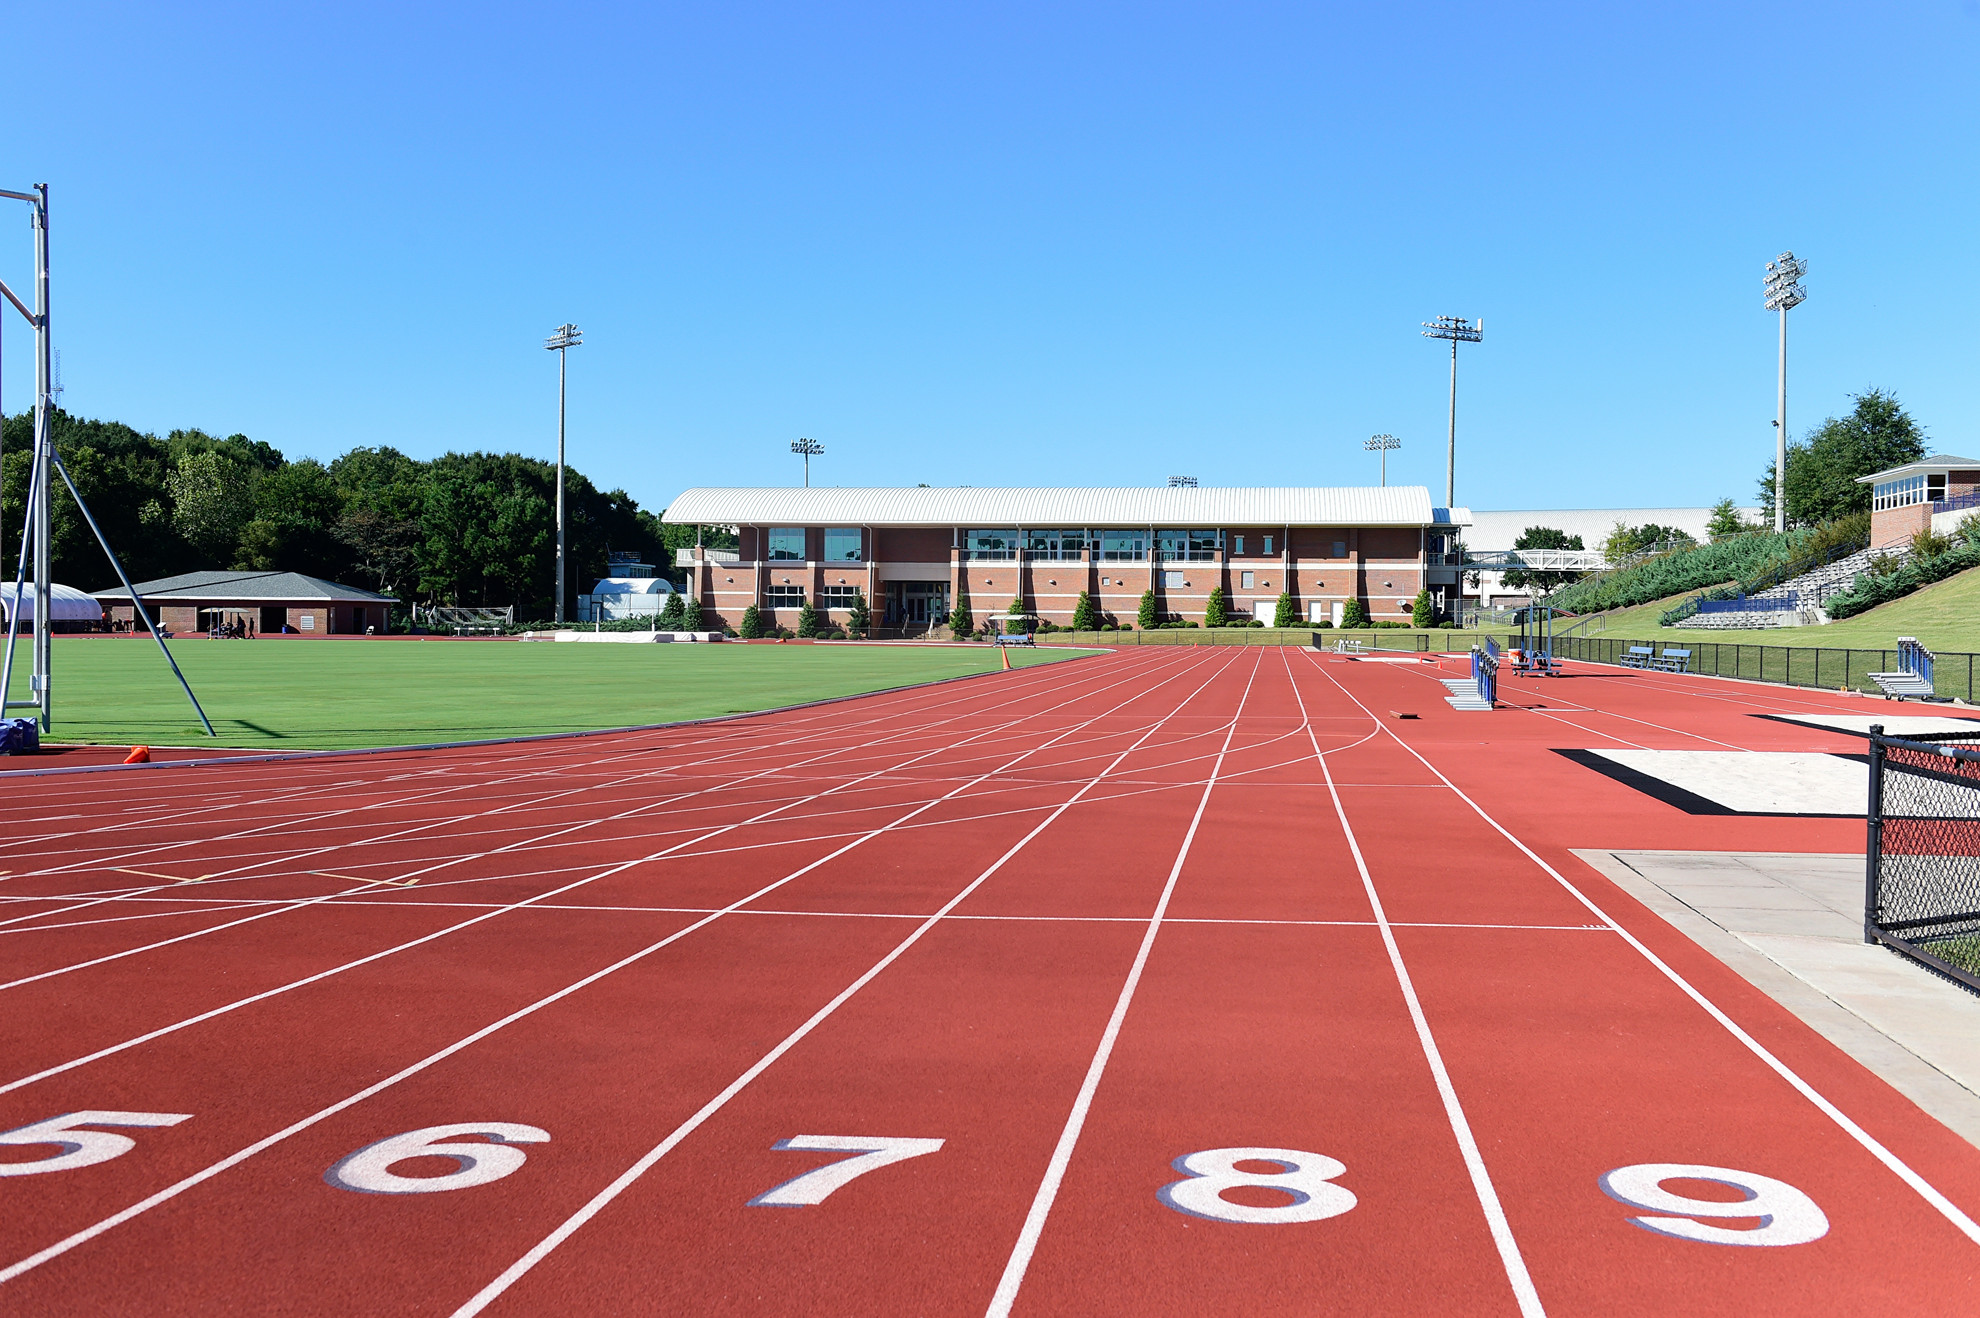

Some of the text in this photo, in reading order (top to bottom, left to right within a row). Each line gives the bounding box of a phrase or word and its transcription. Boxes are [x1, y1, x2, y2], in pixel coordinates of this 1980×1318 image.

[323, 1122, 551, 1194] 6
[745, 1135, 946, 1206] 7
[1156, 1147, 1358, 1223] 8
[1600, 1163, 1829, 1247] 9
